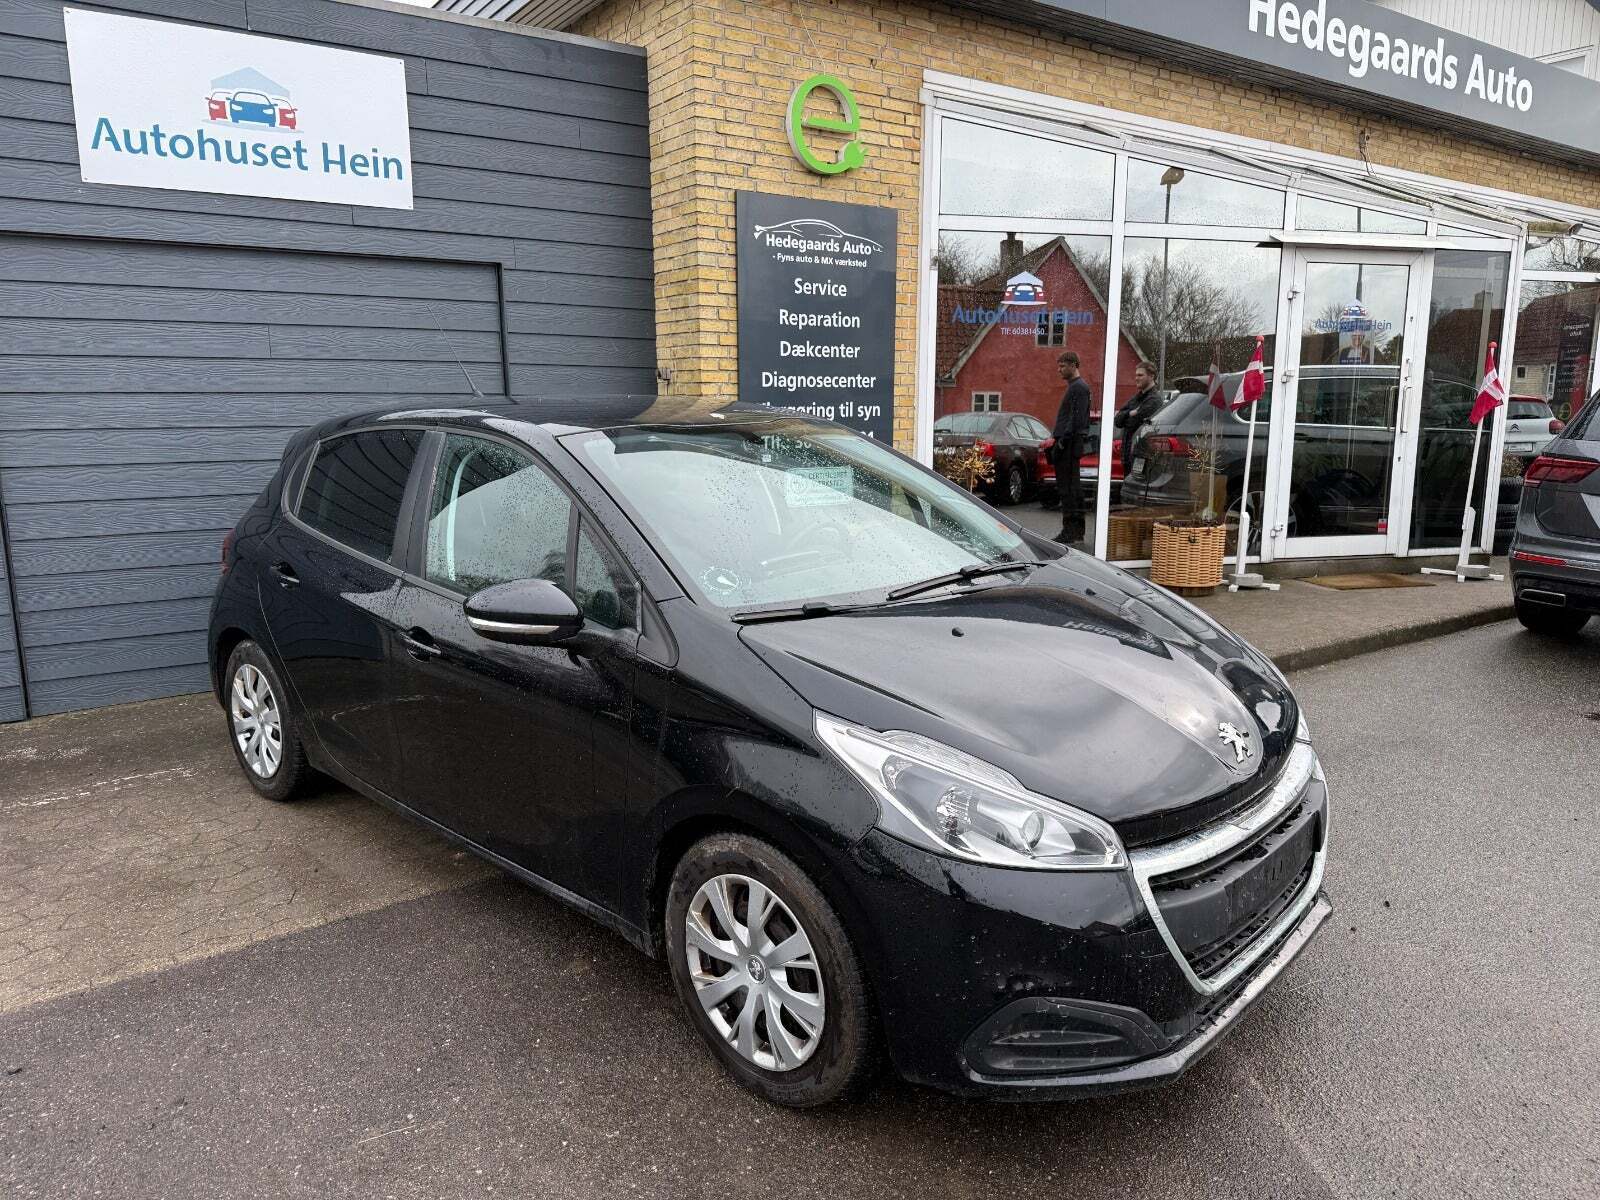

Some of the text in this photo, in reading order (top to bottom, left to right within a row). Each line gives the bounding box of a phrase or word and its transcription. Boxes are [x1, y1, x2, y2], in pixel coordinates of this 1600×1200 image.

[1247, 0, 1534, 112] Hedegaards Auto
[90, 116, 405, 181] Autohuset Hein
[765, 233, 872, 255] Hedegaards Auto
[777, 253, 795, 263] Fyns
[795, 255, 813, 263] auto
[814, 256, 820, 264] &
[821, 256, 834, 265] MX
[834, 258, 867, 268] værksted
[794, 277, 848, 297] Service
[779, 308, 861, 330] Reparation
[1371, 319, 1392, 331] Hein
[780, 340, 861, 359] Dækcenter
[761, 371, 877, 392] Diagnosecenter
[838, 401, 854, 418] til
[857, 405, 881, 421] syn
